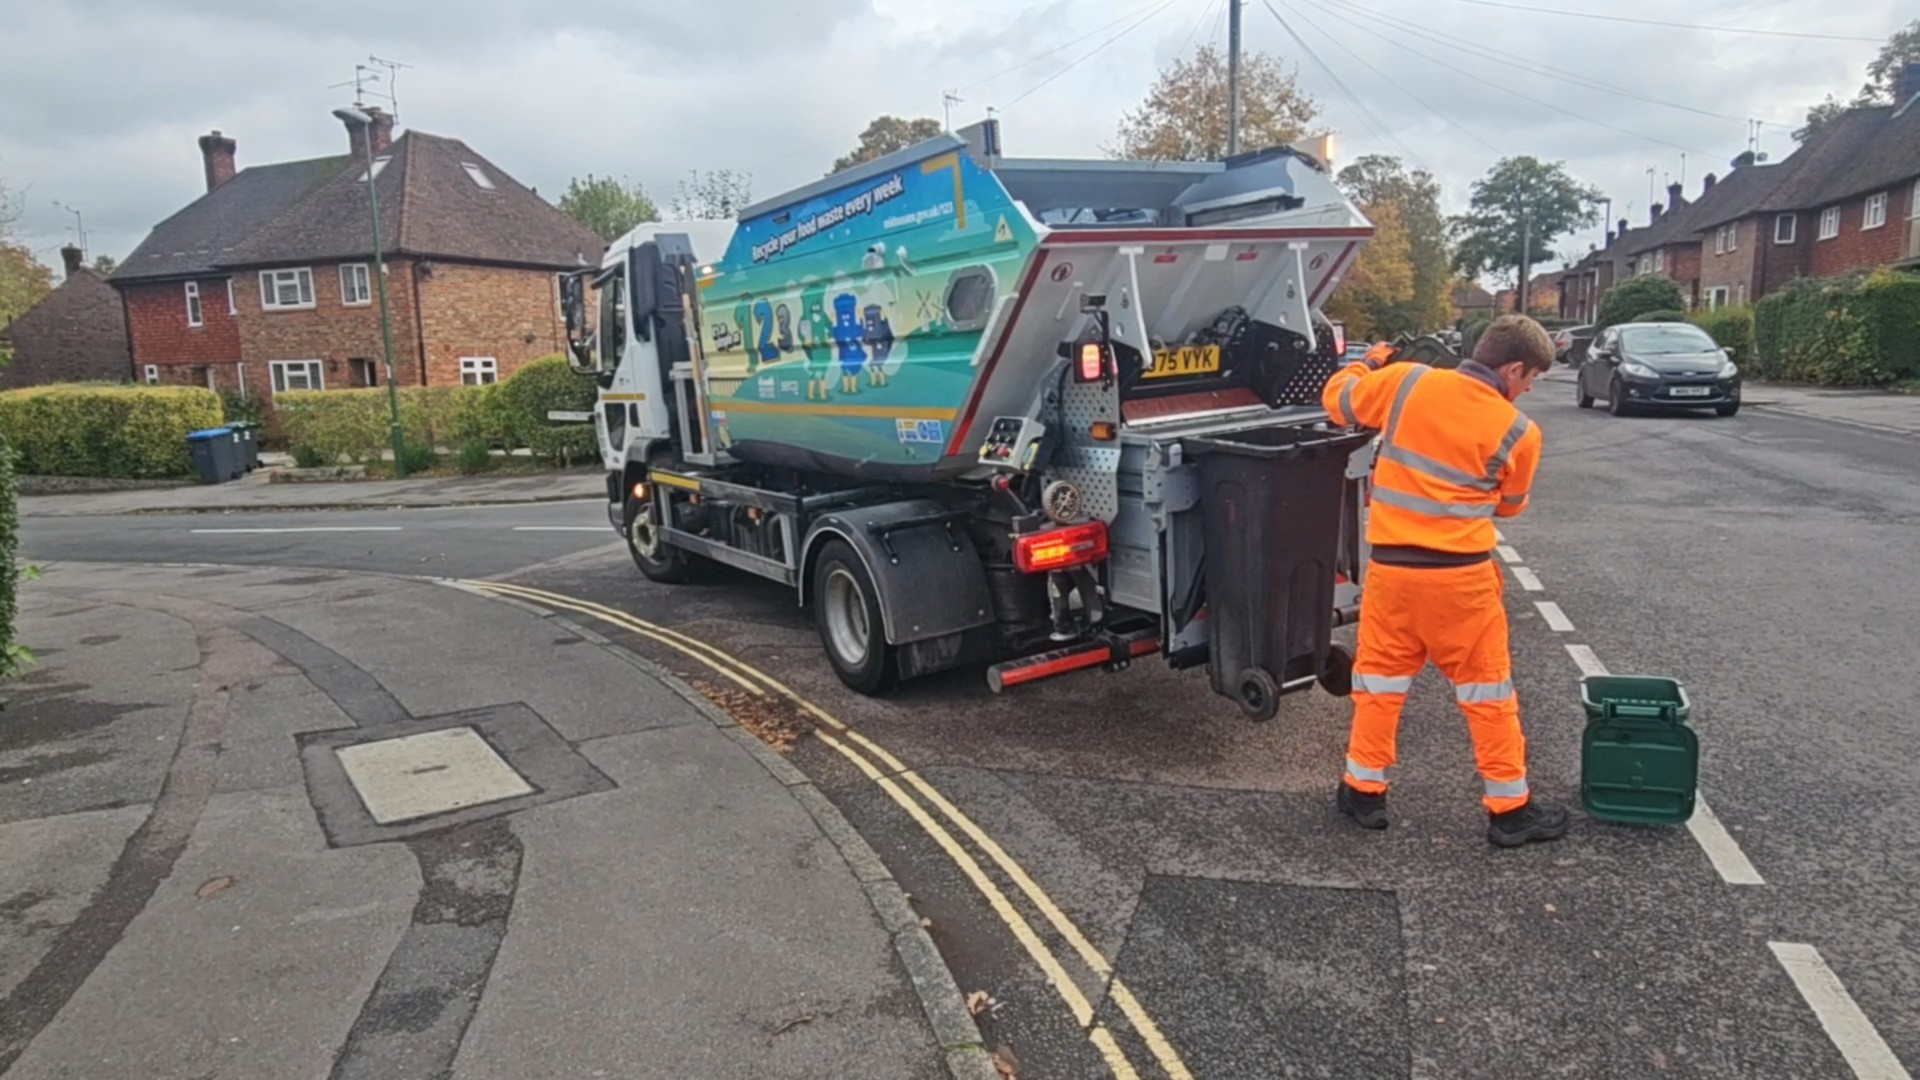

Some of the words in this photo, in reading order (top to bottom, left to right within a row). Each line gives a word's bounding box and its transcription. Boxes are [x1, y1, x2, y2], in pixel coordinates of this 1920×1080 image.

[752, 236, 780, 262] Recycle
[779, 229, 798, 255] your
[797, 213, 817, 240] food
[816, 205, 845, 231] waste
[844, 191, 873, 217] every
[872, 173, 903, 203] week
[734, 292, 759, 373] 1
[754, 297, 781, 363] 2
[775, 303, 794, 353] 3
[1182, 348, 1214, 370] VYK
